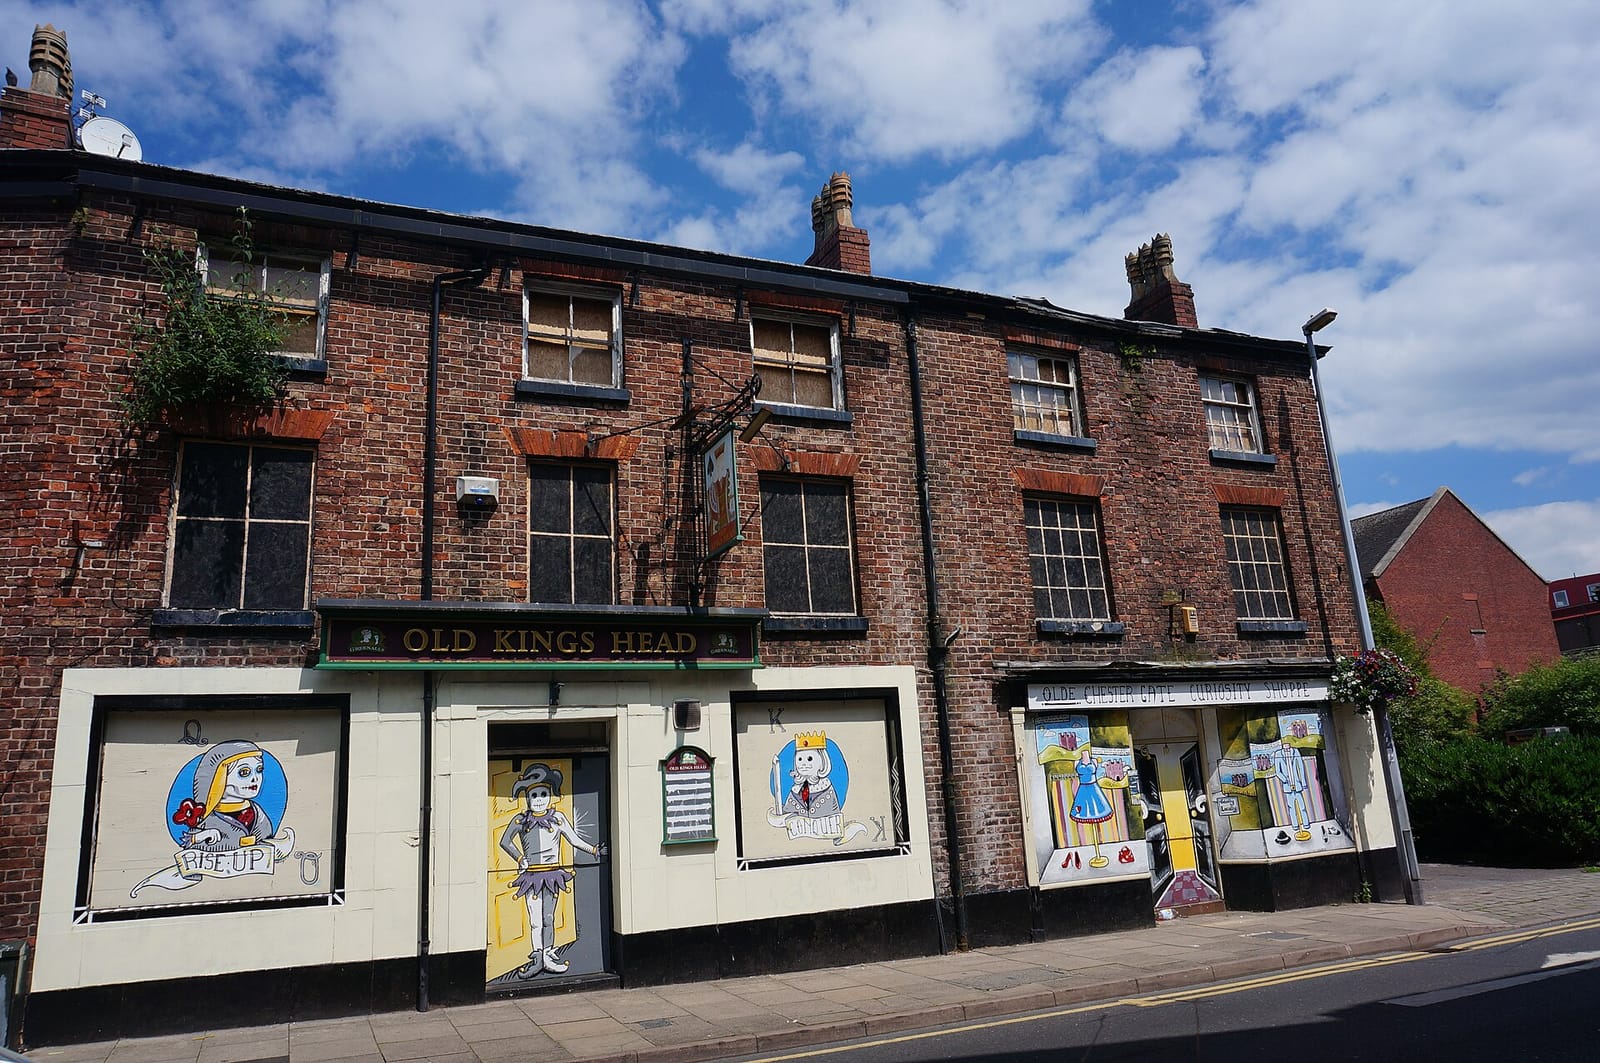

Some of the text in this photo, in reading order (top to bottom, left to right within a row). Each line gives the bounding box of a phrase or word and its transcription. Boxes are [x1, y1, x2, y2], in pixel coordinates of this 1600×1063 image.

[403, 628, 697, 654] OLD KINGS HEAD
[1042, 681, 1310, 704] OLDE CHESTER GATE CURIOSITY SHOPPE
[789, 814, 842, 837] CONQUER
[182, 848, 265, 872] RISE UP
